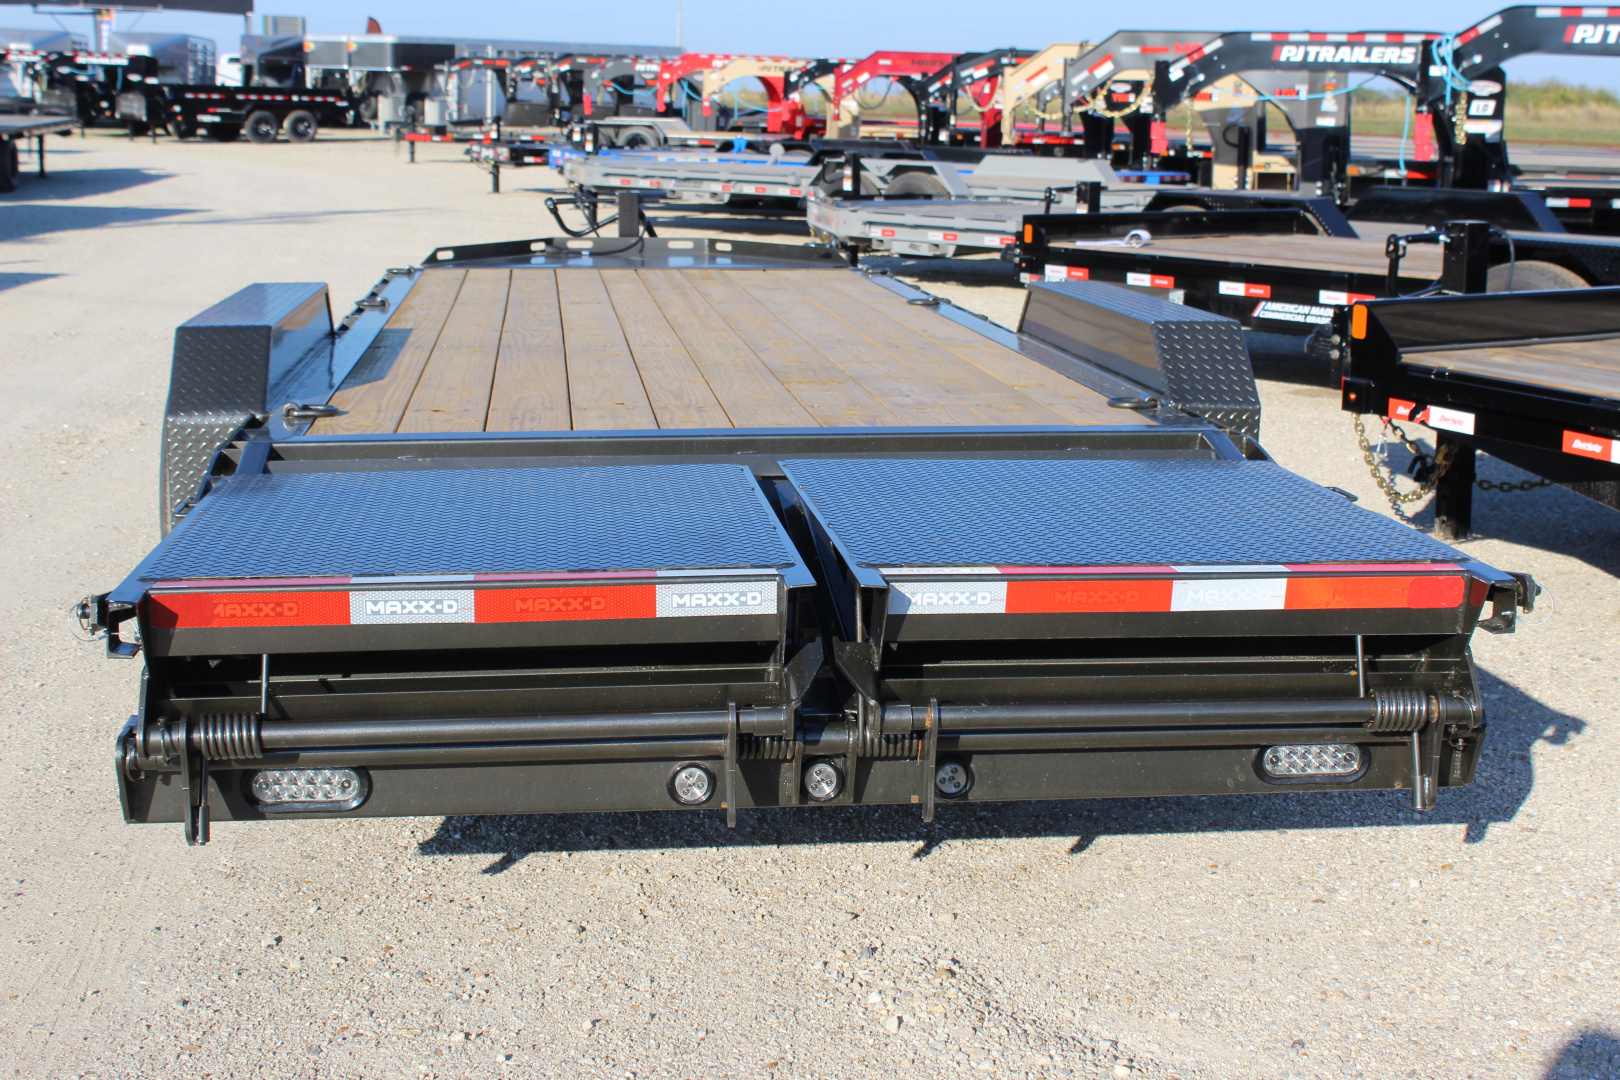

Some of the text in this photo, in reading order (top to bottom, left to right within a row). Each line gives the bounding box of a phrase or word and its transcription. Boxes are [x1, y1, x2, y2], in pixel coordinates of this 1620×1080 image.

[1572, 24, 1606, 44] PJ
[1278, 45, 1417, 64] PJ TRAILERS
[1264, 301, 1311, 315] AMERICAN
[515, 596, 605, 612] MAXX-D
[672, 592, 762, 608] MAXX-D
[907, 591, 992, 606] MAXX-D
[1054, 590, 1140, 605] MAXX-D
[1188, 589, 1273, 604] MAXX-D
[366, 599, 458, 615] MAXX-D
